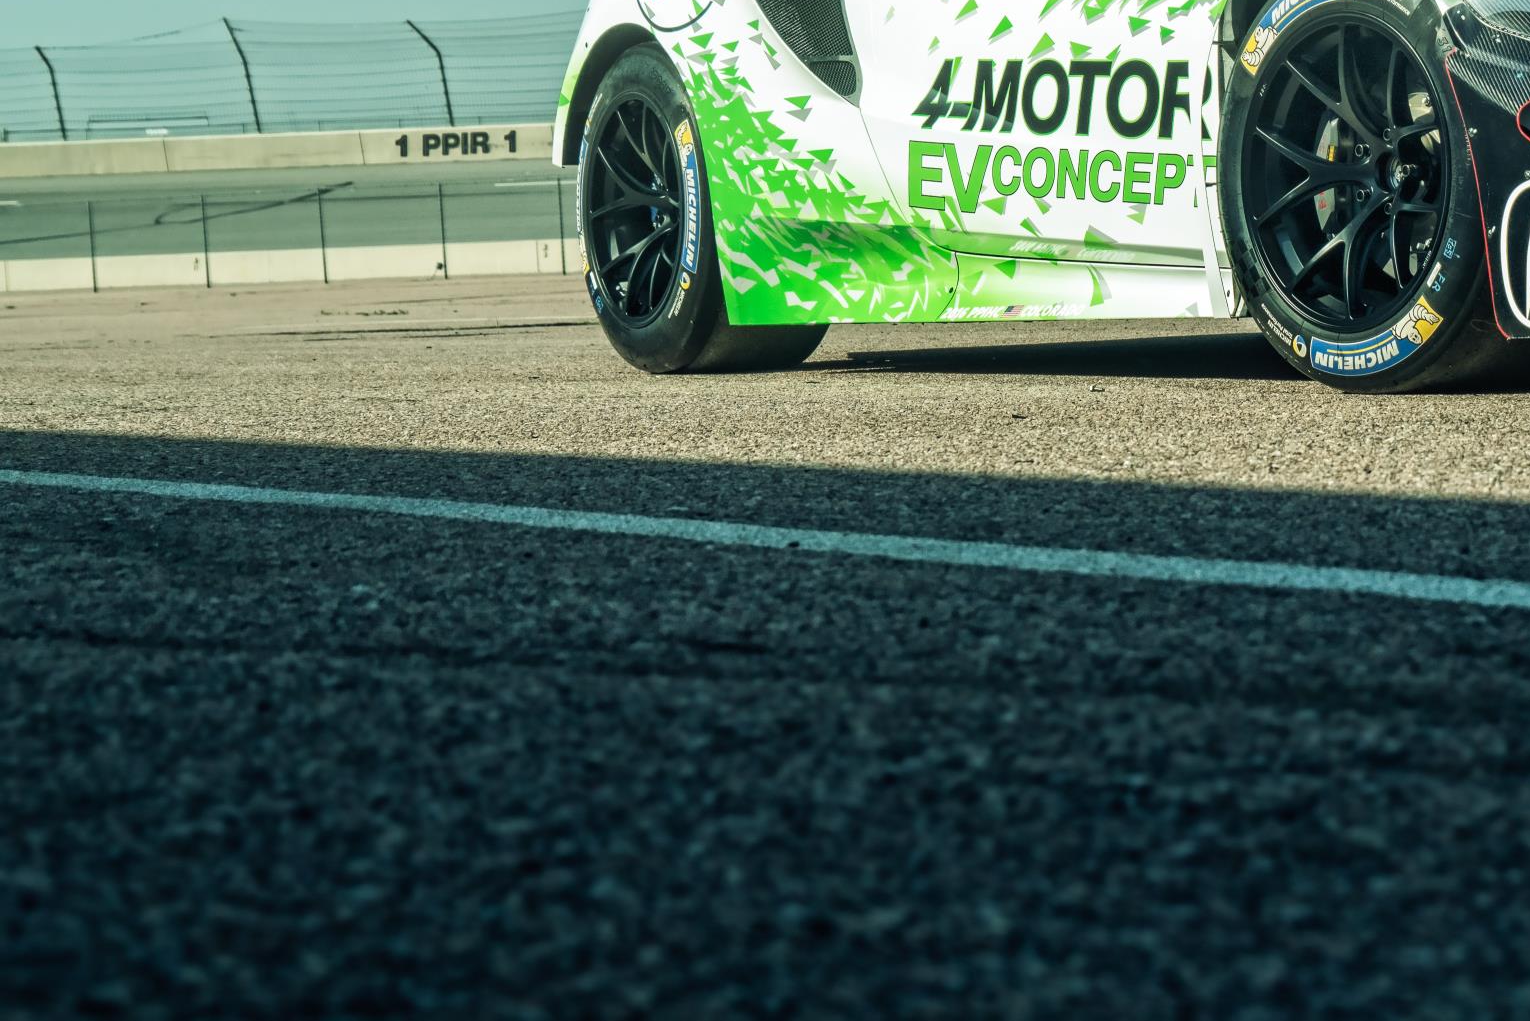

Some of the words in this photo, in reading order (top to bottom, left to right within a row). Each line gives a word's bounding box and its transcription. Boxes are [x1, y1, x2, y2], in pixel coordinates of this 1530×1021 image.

[912, 58, 1212, 141] 4-MOTOR
[395, 134, 409, 157] 1
[422, 131, 490, 157] PPIR
[504, 130, 517, 153] 1
[685, 167, 698, 267] MICHELIN
[1314, 339, 1400, 370] MICHELIN
